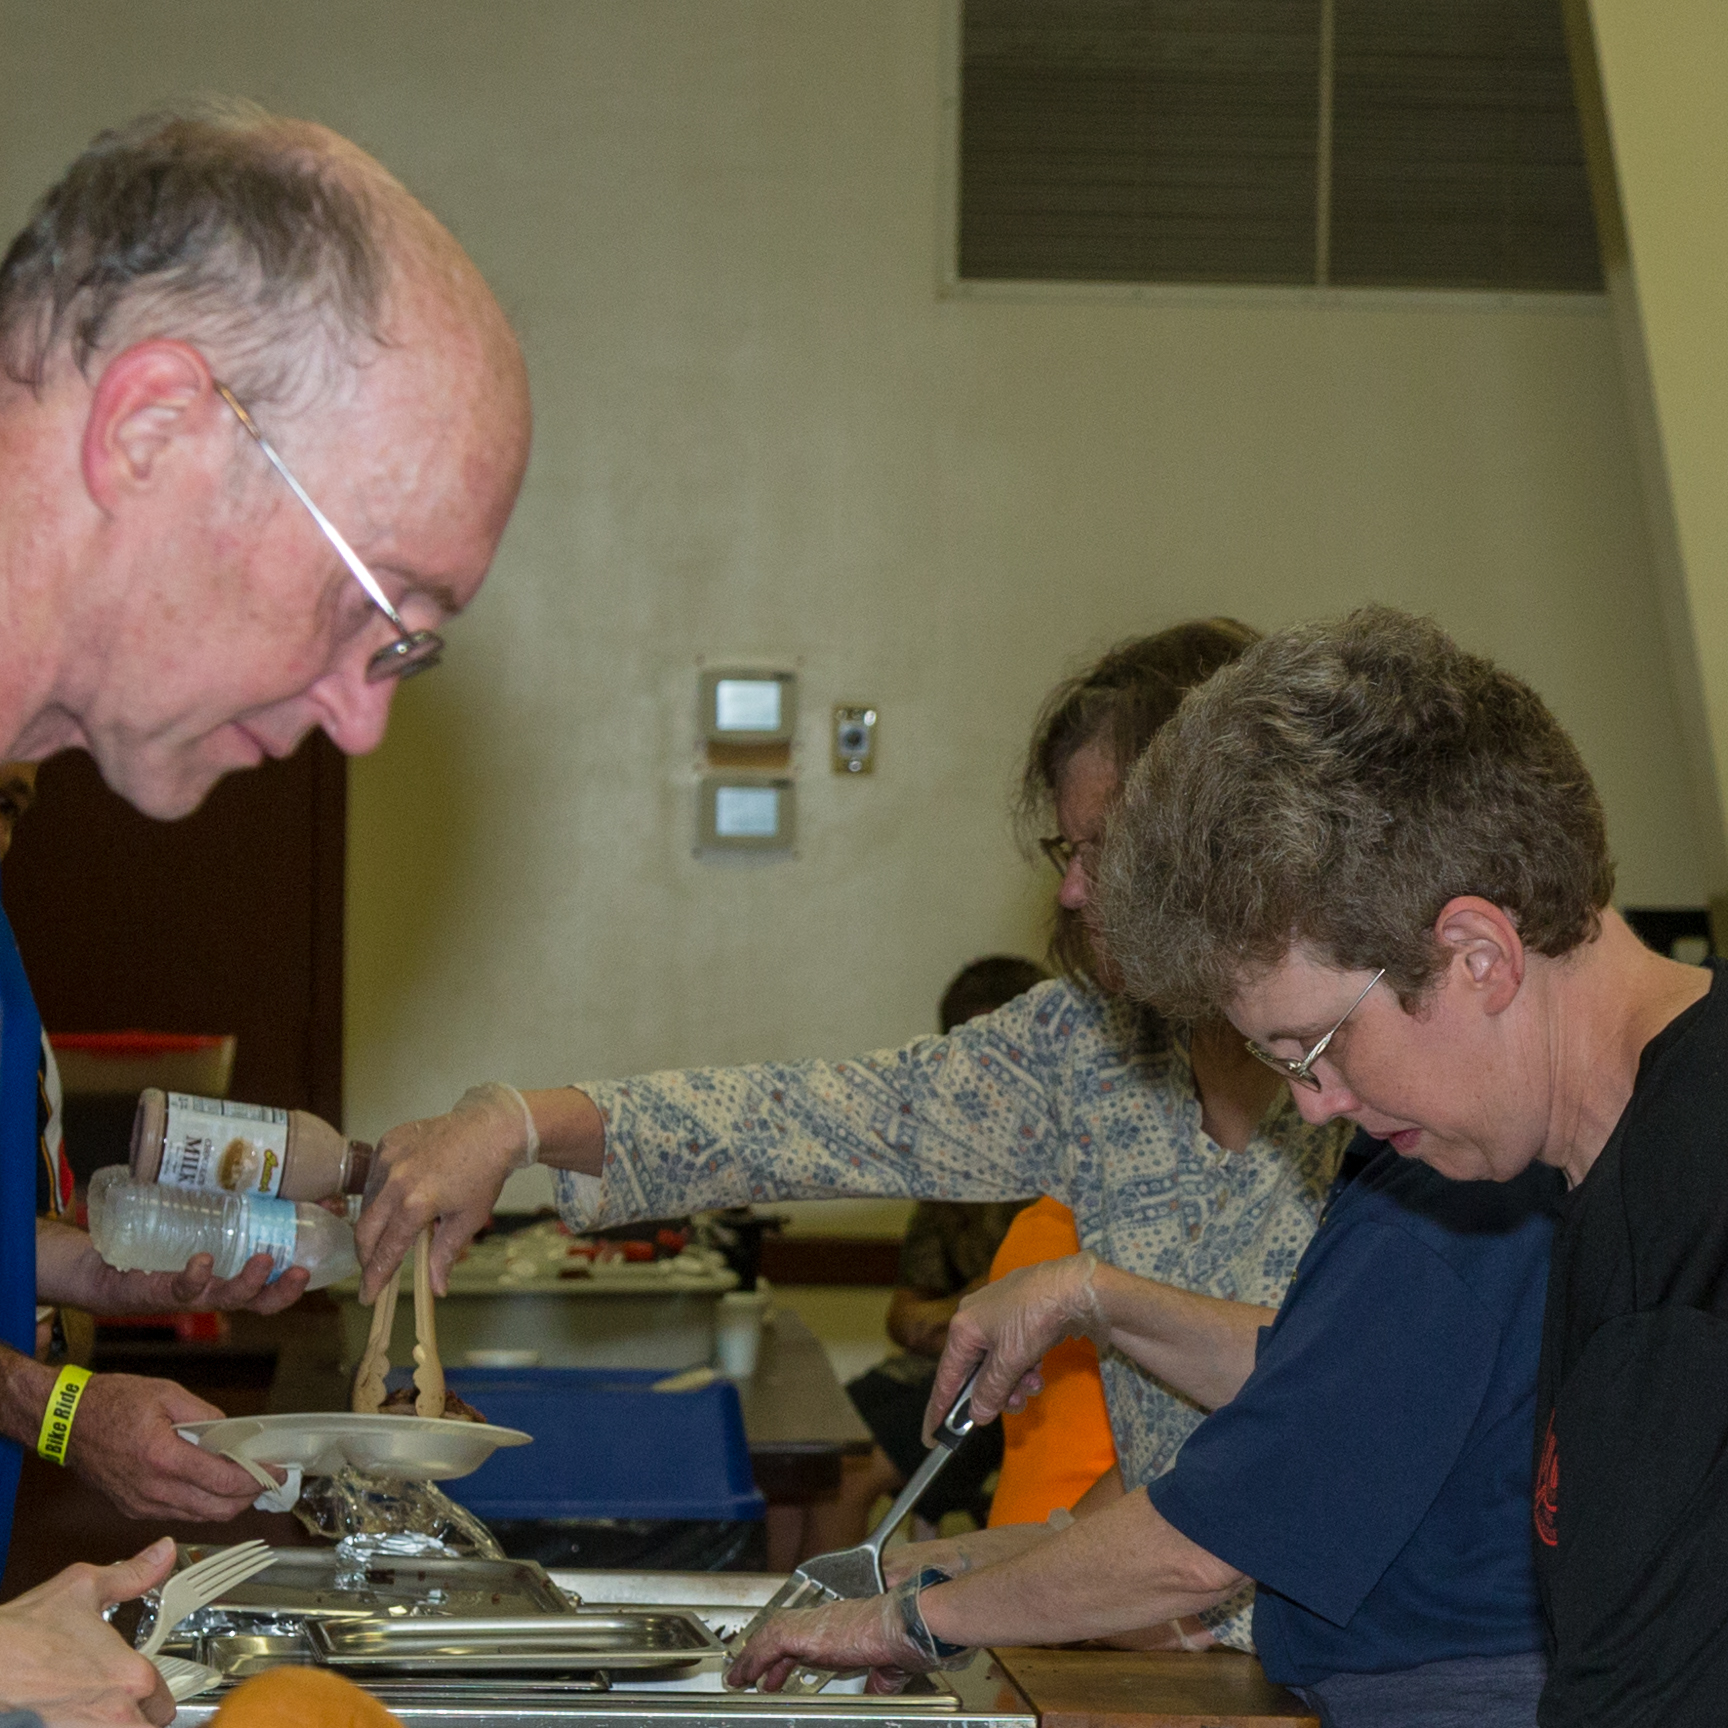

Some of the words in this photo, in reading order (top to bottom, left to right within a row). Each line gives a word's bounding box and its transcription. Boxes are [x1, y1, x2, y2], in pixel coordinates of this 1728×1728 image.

[179, 1135, 202, 1184] MILK
[53, 1383, 80, 1420] Ride
[45, 1421, 68, 1454] Bike
